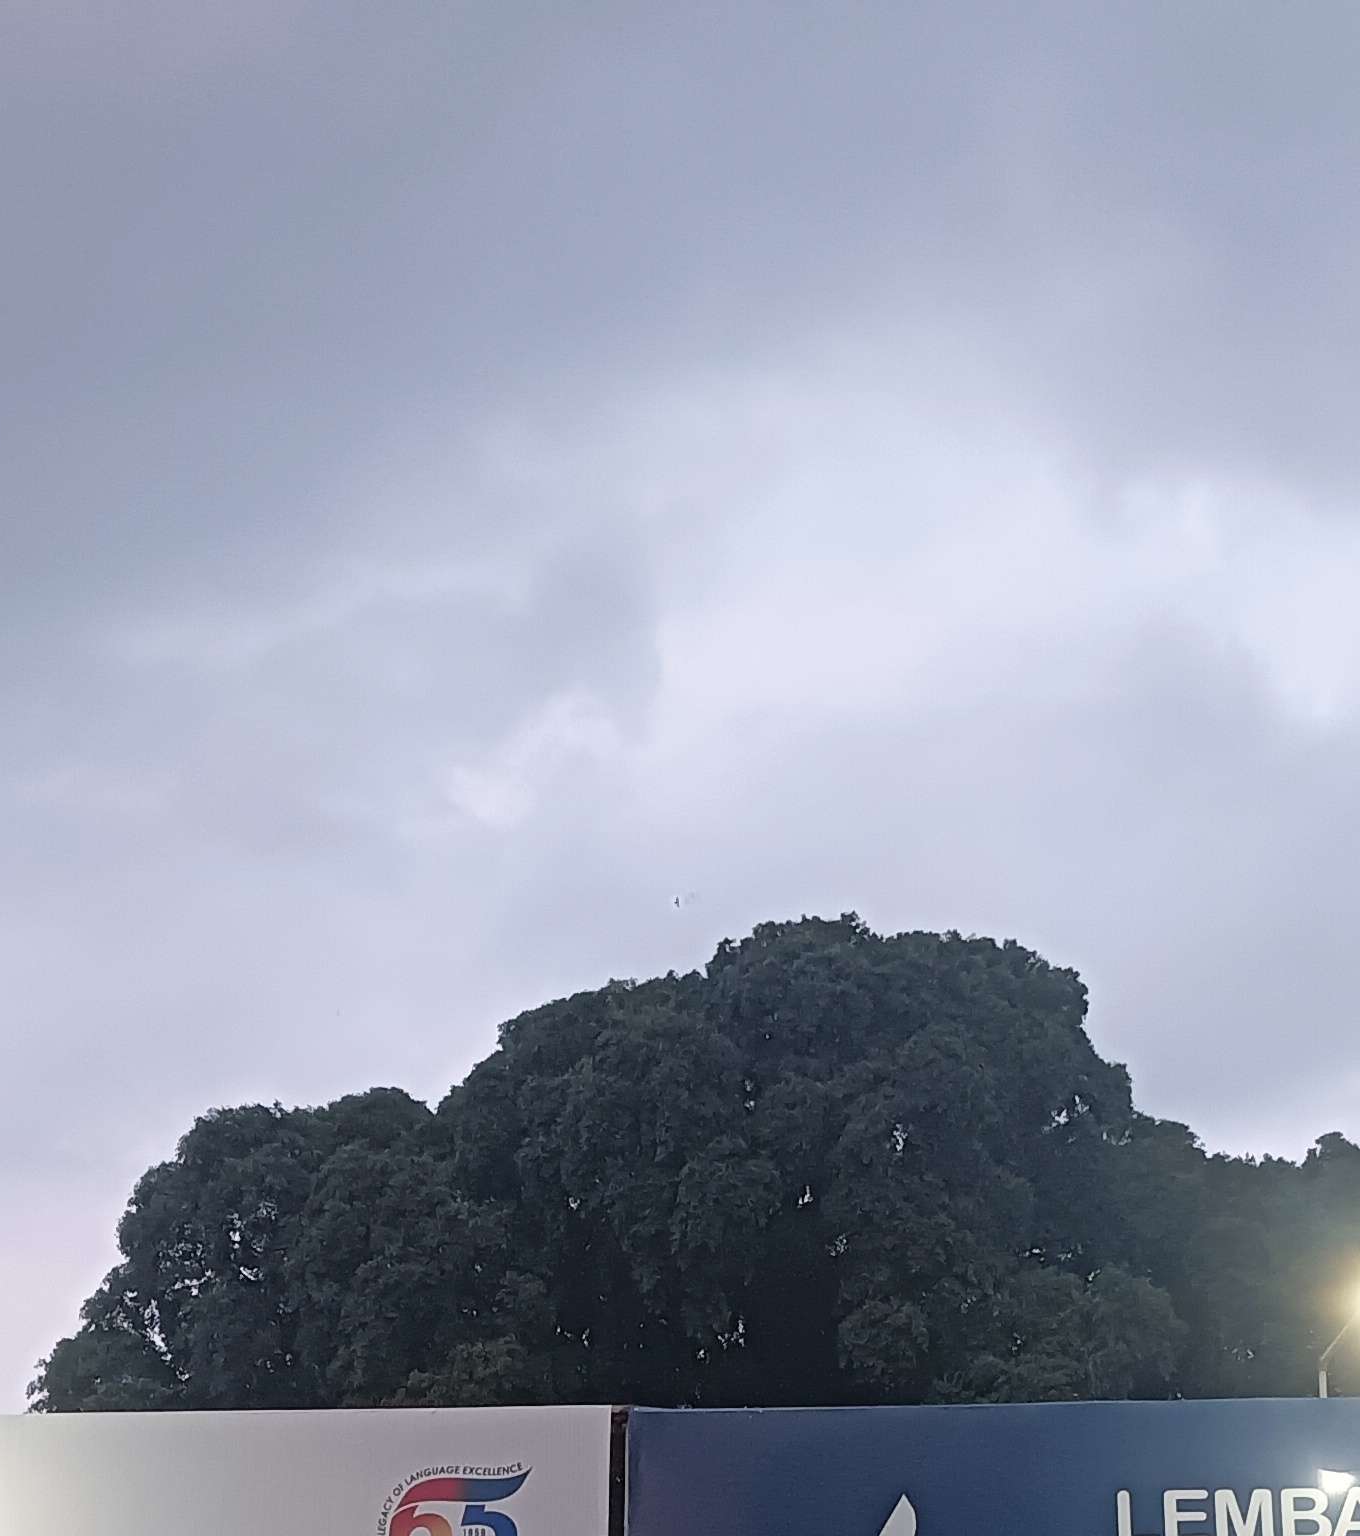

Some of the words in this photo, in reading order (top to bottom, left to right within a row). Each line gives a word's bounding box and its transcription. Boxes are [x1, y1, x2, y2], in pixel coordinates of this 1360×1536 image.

[377, 1497, 394, 1536] LEGACY
[392, 1482, 405, 1498] OF
[404, 1465, 461, 1486] LANGUAGE
[462, 1461, 524, 1477] EXCELLENCE
